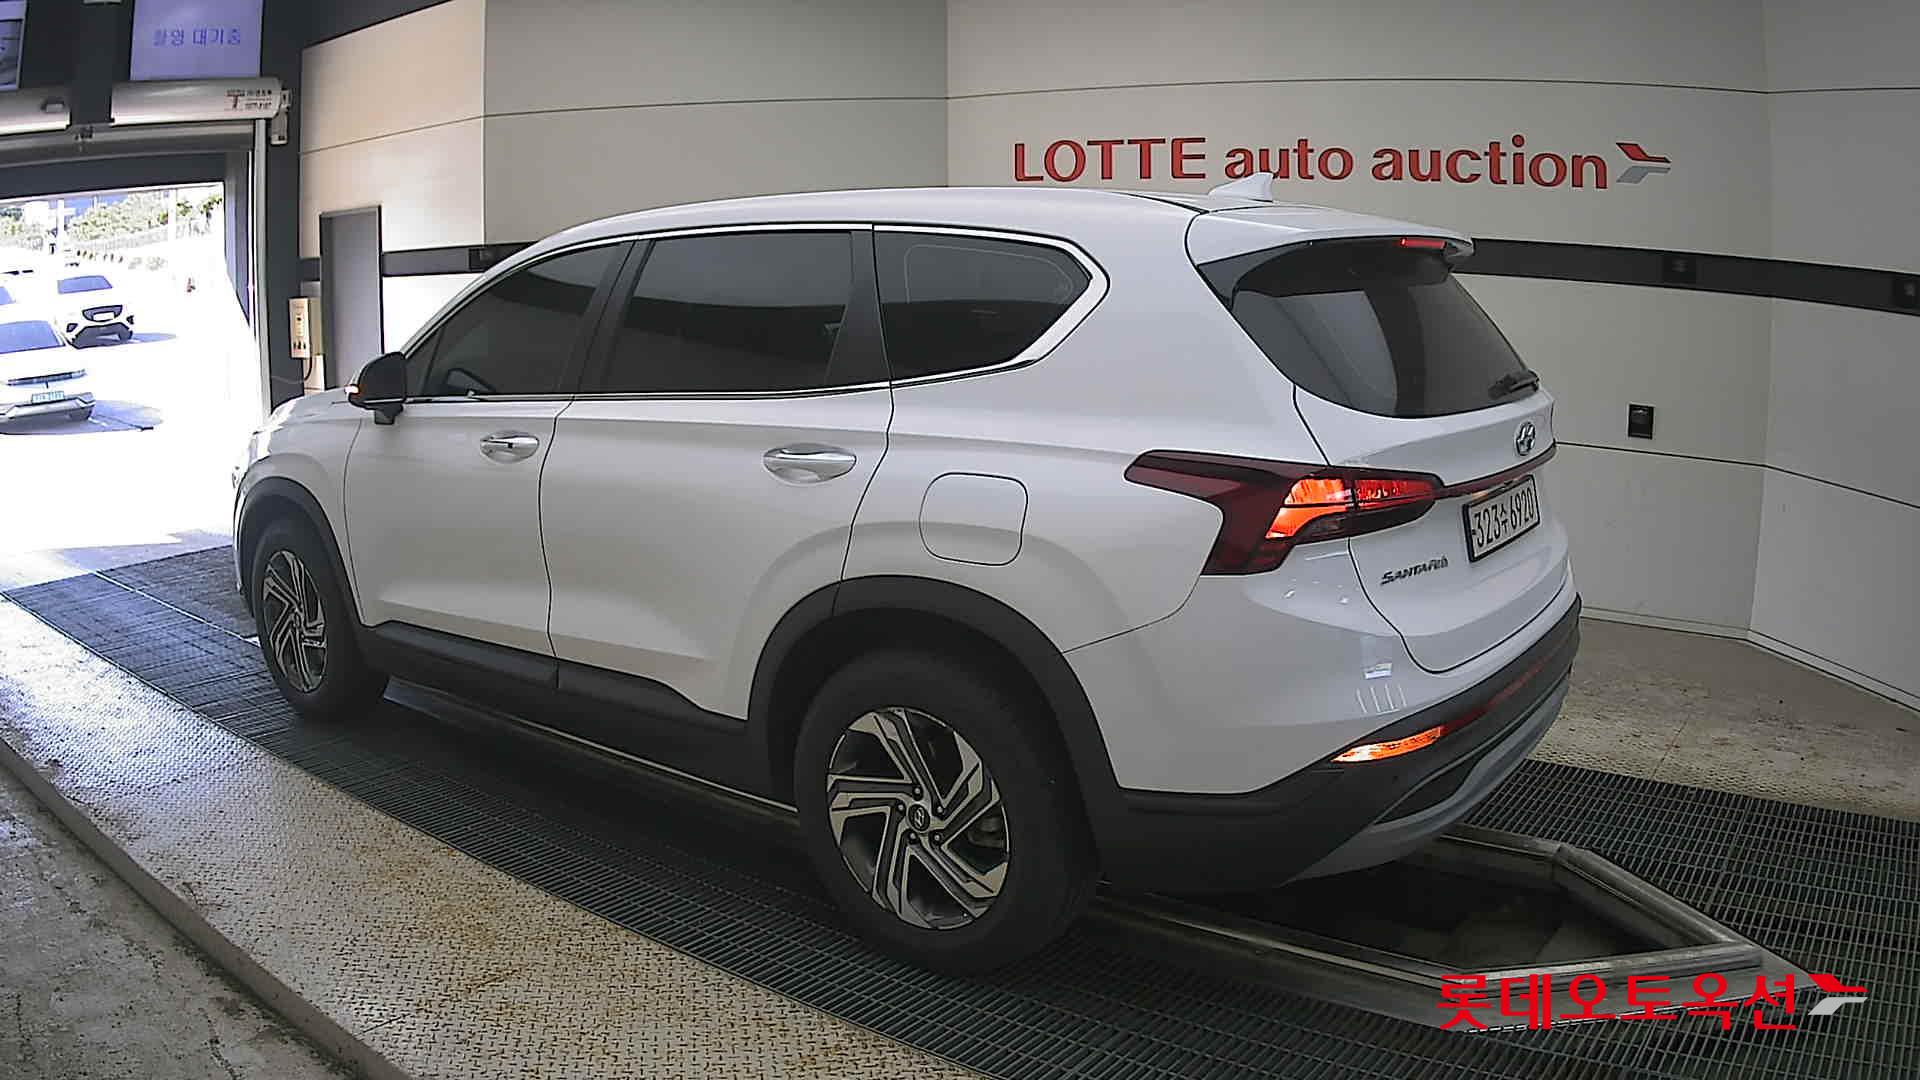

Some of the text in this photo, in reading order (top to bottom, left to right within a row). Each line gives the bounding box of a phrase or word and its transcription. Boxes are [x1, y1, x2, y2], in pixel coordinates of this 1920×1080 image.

[1014, 134, 1608, 189] LOTTE auto auction
